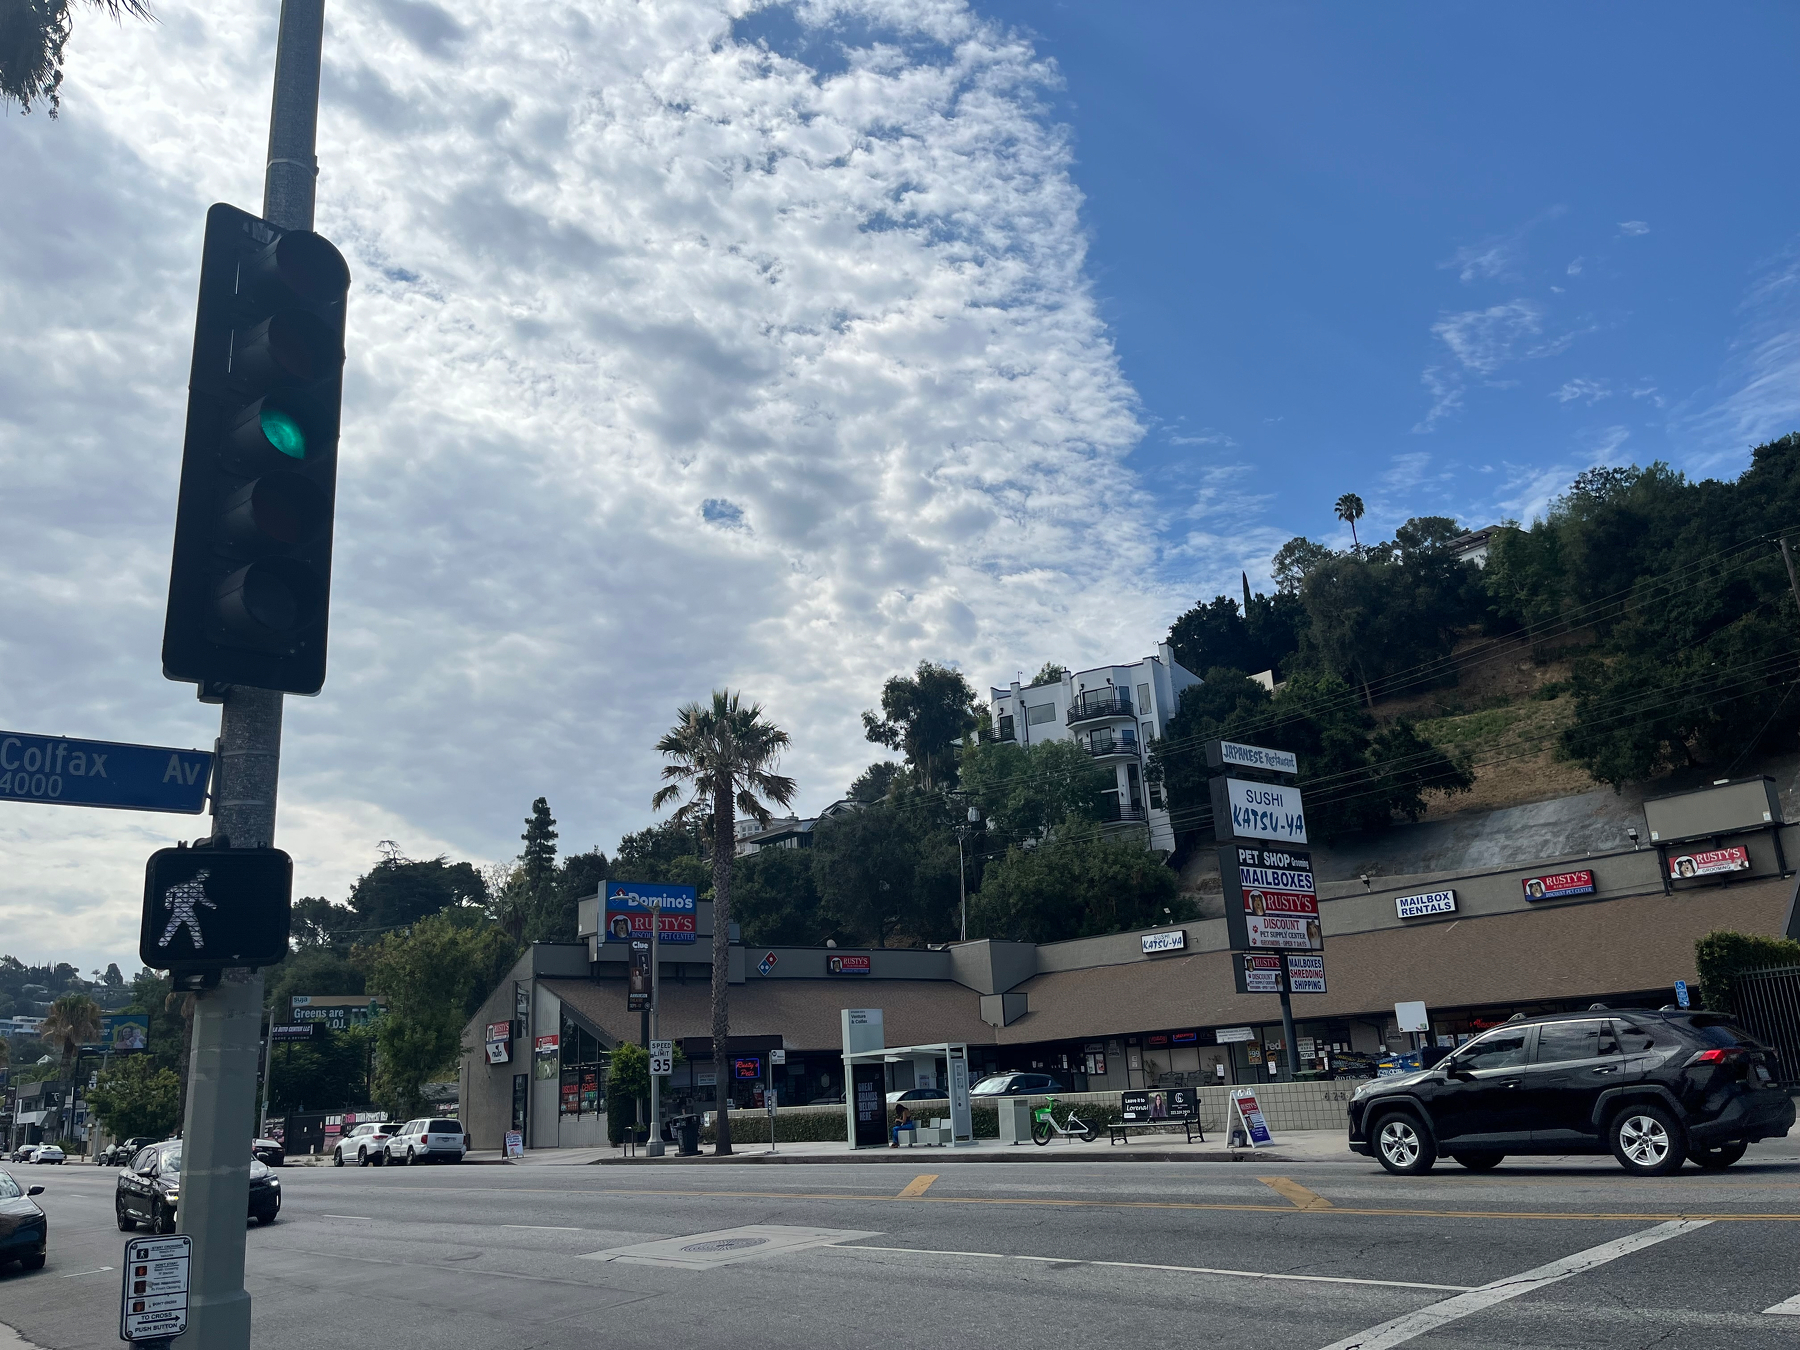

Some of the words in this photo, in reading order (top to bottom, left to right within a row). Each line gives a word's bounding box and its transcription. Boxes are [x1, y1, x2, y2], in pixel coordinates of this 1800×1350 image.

[0, 737, 108, 778] Colfax
[162, 753, 202, 786] Av
[1224, 744, 1264, 764] JAPANESE
[1265, 752, 1295, 768] Restaurant
[0, 771, 63, 798] 4000
[1246, 789, 1284, 808] SUSHI
[1233, 803, 1304, 837] KATSU-YA
[1238, 848, 1259, 865] PET
[1263, 851, 1291, 868] SHOP
[1291, 857, 1310, 870] Grooming
[1695, 847, 1741, 863] RUSTY'S
[1701, 865, 1731, 873] GROOMING
[1240, 868, 1313, 889] MAILBOXES
[1545, 871, 1588, 886] RUSTY'S
[628, 892, 693, 909] Domino's
[1266, 893, 1313, 911] RUSTY'S
[1400, 892, 1451, 908] MAILBOX
[1401, 901, 1452, 917] RENTALS
[1263, 918, 1300, 931] DISCOUNT
[660, 932, 672, 940] PET
[672, 933, 695, 941] CENTER
[1143, 936, 1183, 949] KATSU-YA
[632, 941, 649, 949] Clue
[843, 957, 868, 965] RUSTY'S
[1255, 957, 1280, 967] RUSTY'S
[1289, 958, 1322, 968] MAILBOXES
[1289, 969, 1323, 979] SHREDDING
[1294, 980, 1322, 990] SHIPPING
[294, 1008, 327, 1018] Greens
[328, 1009, 344, 1018] are
[653, 1058, 671, 1072] 35
[736, 1061, 758, 1069] Rusty's
[858, 1082, 873, 1092] GREAT
[858, 1091, 878, 1101] BRANDS
[858, 1101, 878, 1111] BELONG
[859, 1111, 872, 1121] HERE
[153, 1323, 178, 1331] BUTTON
